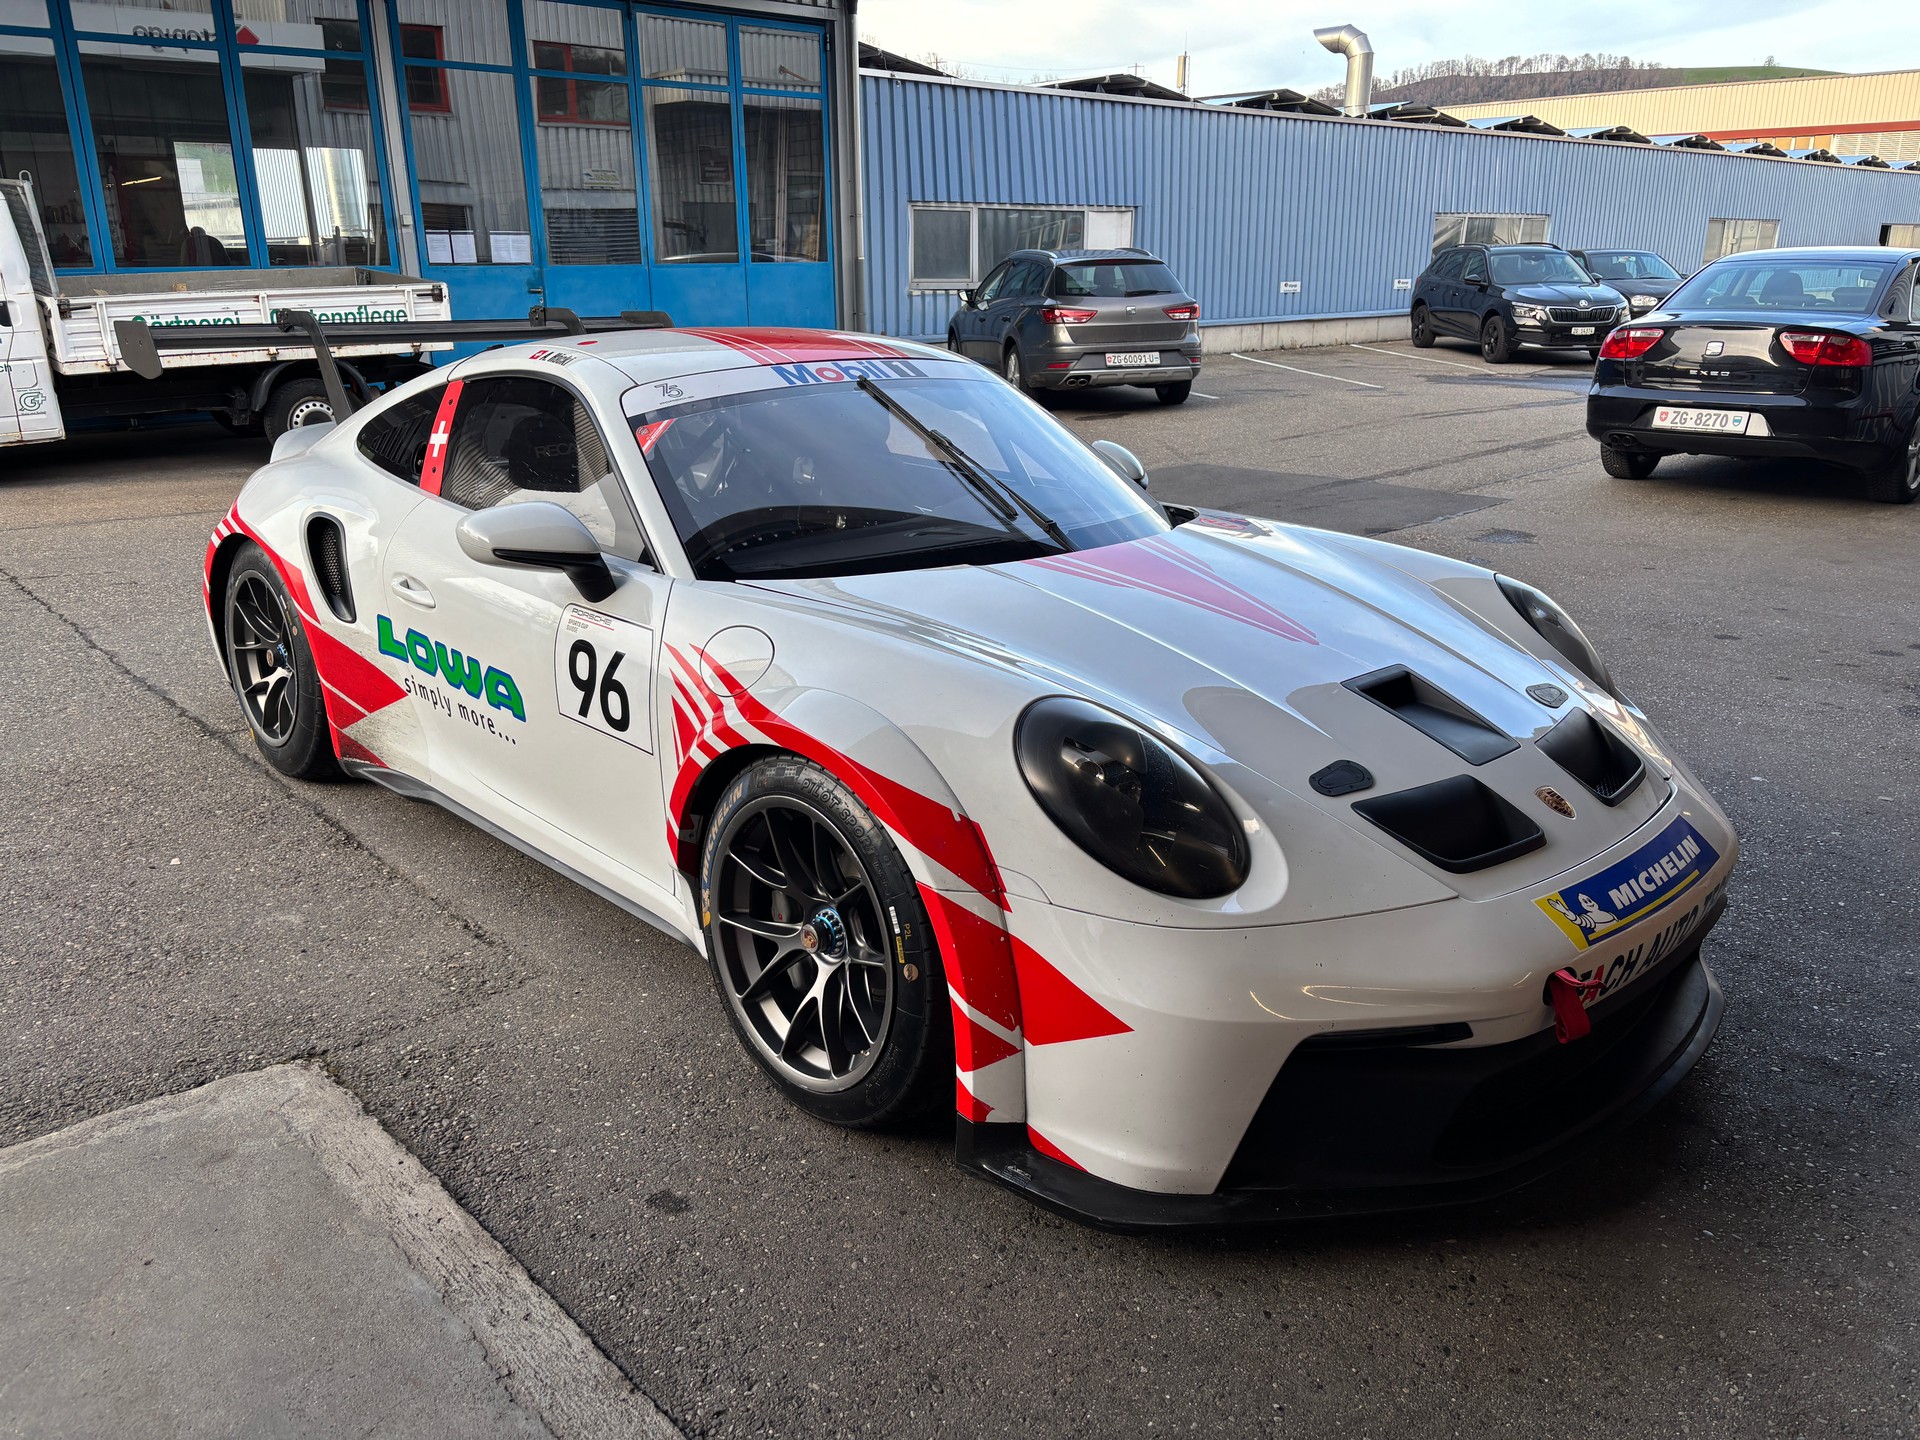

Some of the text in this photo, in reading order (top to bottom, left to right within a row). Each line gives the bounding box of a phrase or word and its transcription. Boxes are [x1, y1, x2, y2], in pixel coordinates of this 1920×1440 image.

[653, 383, 684, 398] 75
[771, 361, 892, 385] Mobil
[571, 607, 613, 627] PORSCHE
[377, 614, 527, 723] LOWA
[568, 639, 631, 733] 96
[404, 675, 517, 745] simply more...
[801, 778, 841, 811] PILOT
[703, 782, 744, 883] MICHELIN
[1608, 834, 1701, 911] MICHELIN
[1635, 904, 1699, 977] AUTO
